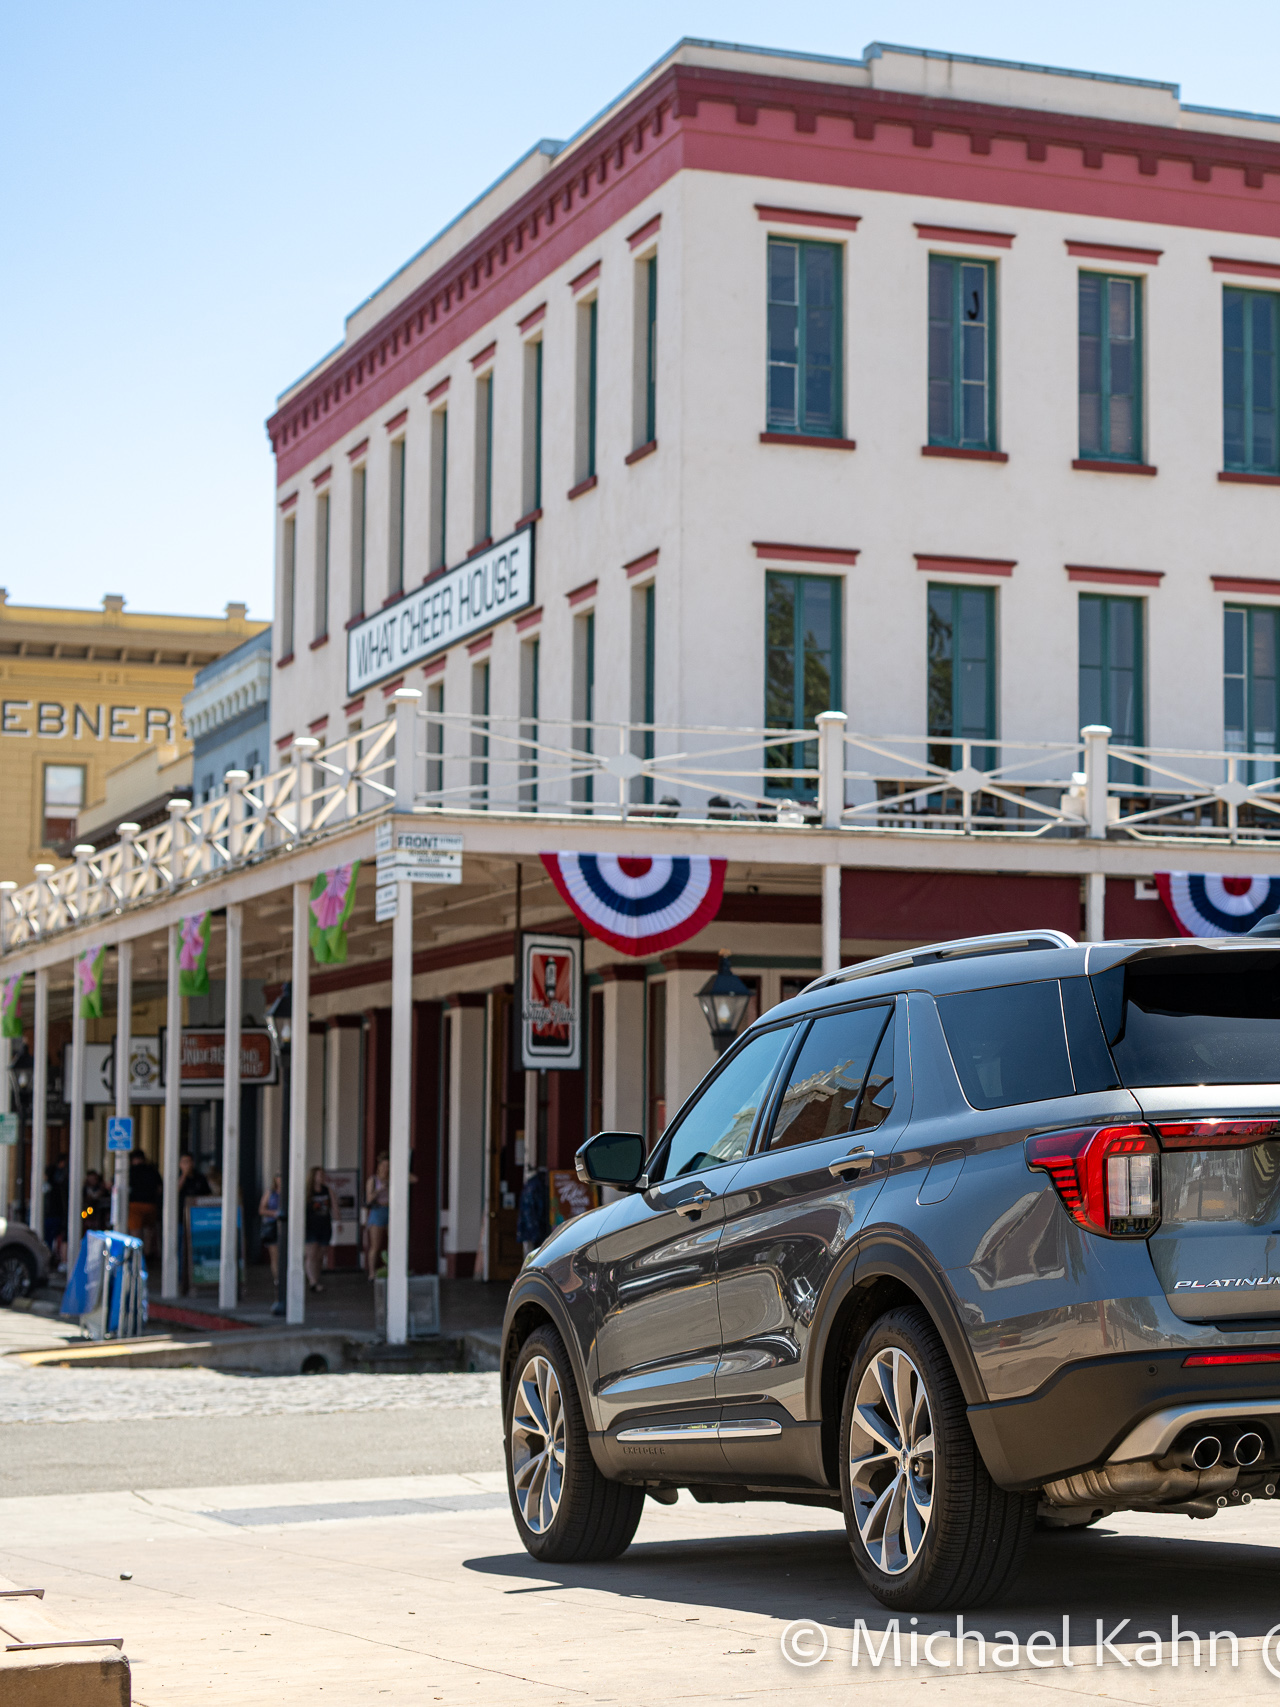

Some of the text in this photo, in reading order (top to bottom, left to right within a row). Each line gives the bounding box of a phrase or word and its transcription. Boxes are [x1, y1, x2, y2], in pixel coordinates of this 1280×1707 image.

[356, 547, 518, 678] WHAT CHEER HOUSE
[2, 701, 188, 744] EBNER
[398, 836, 438, 848] FRONT
[623, 1446, 666, 1455] EXPLORER
